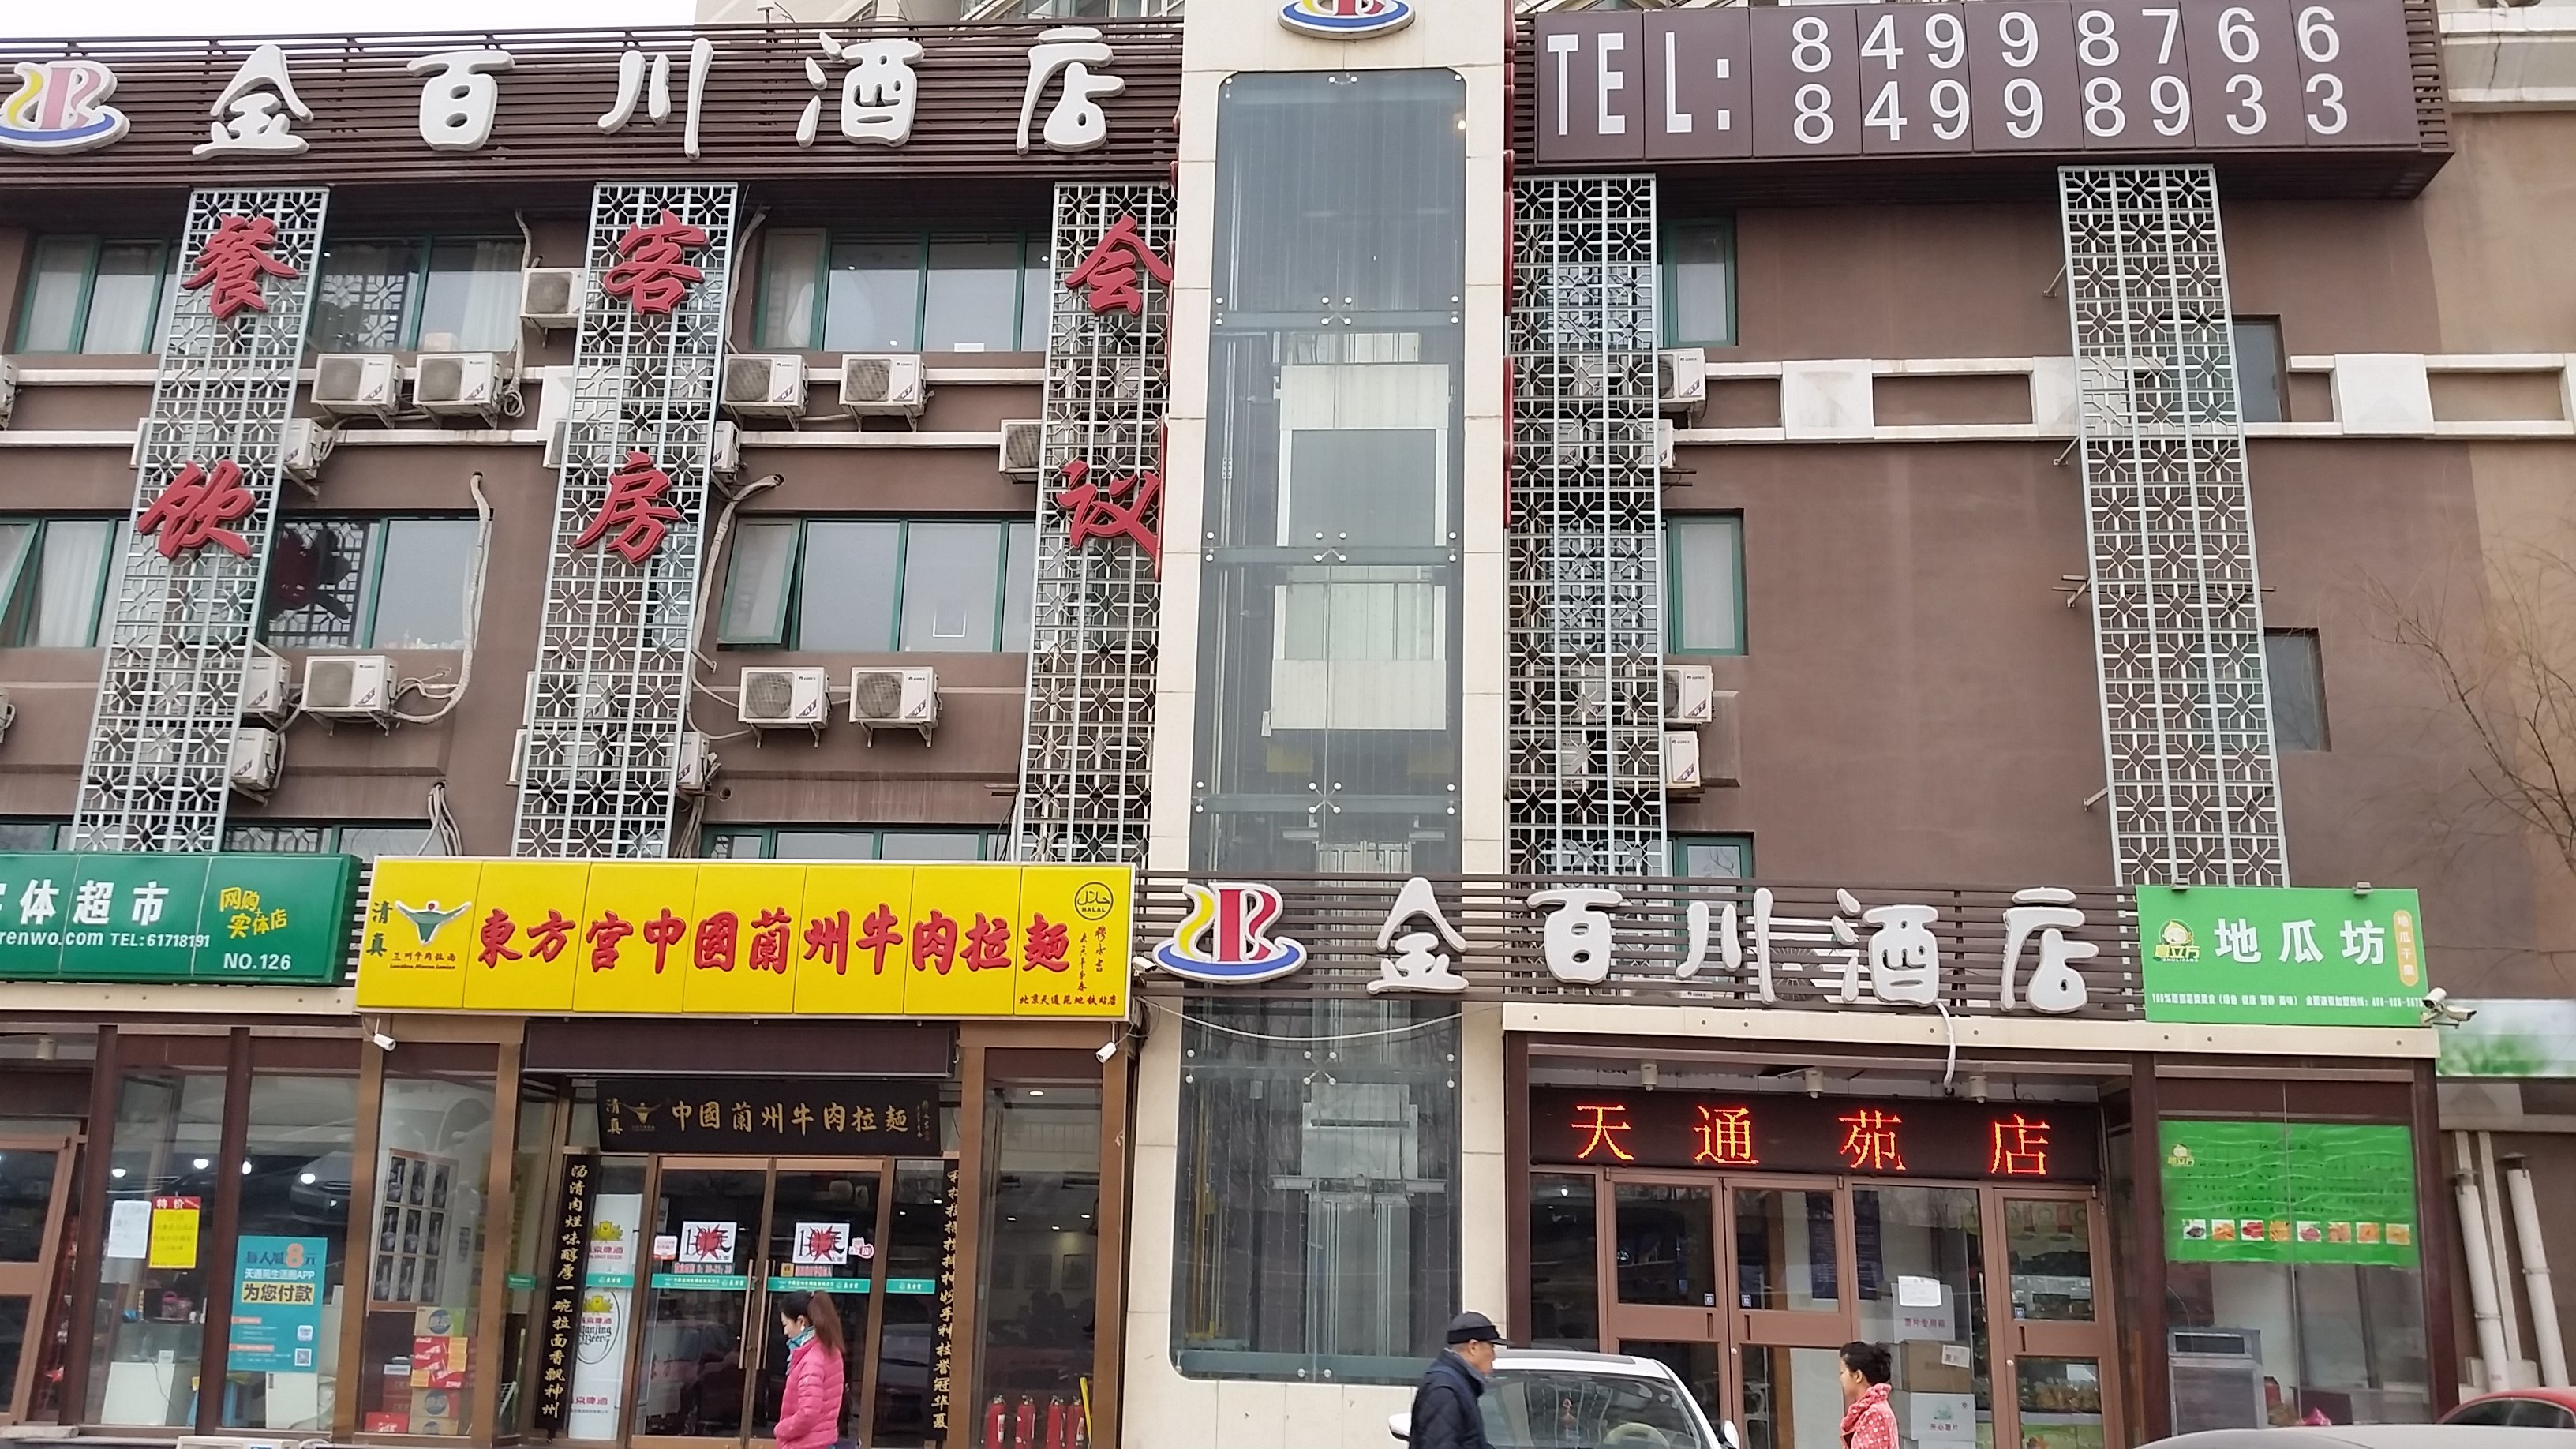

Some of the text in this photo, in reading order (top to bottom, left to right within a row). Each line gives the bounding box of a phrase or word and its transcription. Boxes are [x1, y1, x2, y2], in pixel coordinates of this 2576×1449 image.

[1792, 6, 2340, 73] 84998766
[193, 27, 1125, 159] 金百川酒店
[1793, 73, 2348, 145] 84998933
[574, 208, 710, 564] 客房
[219, 887, 260, 912] 网购
[227, 908, 287, 939] 实体店
[366, 900, 393, 957] 清真
[1366, 876, 2100, 1014] 金百川酒店
[2214, 918, 2385, 964] 地瓜坊
[223, 953, 291, 970] NO.126
[606, 1098, 623, 1135] 清真
[1571, 1104, 2054, 1176] 天通苑店
[590, 1245, 623, 1254] 京啤酒
[244, 1284, 313, 1302] 为您付款
[572, 1396, 608, 1405] 京啤酒
